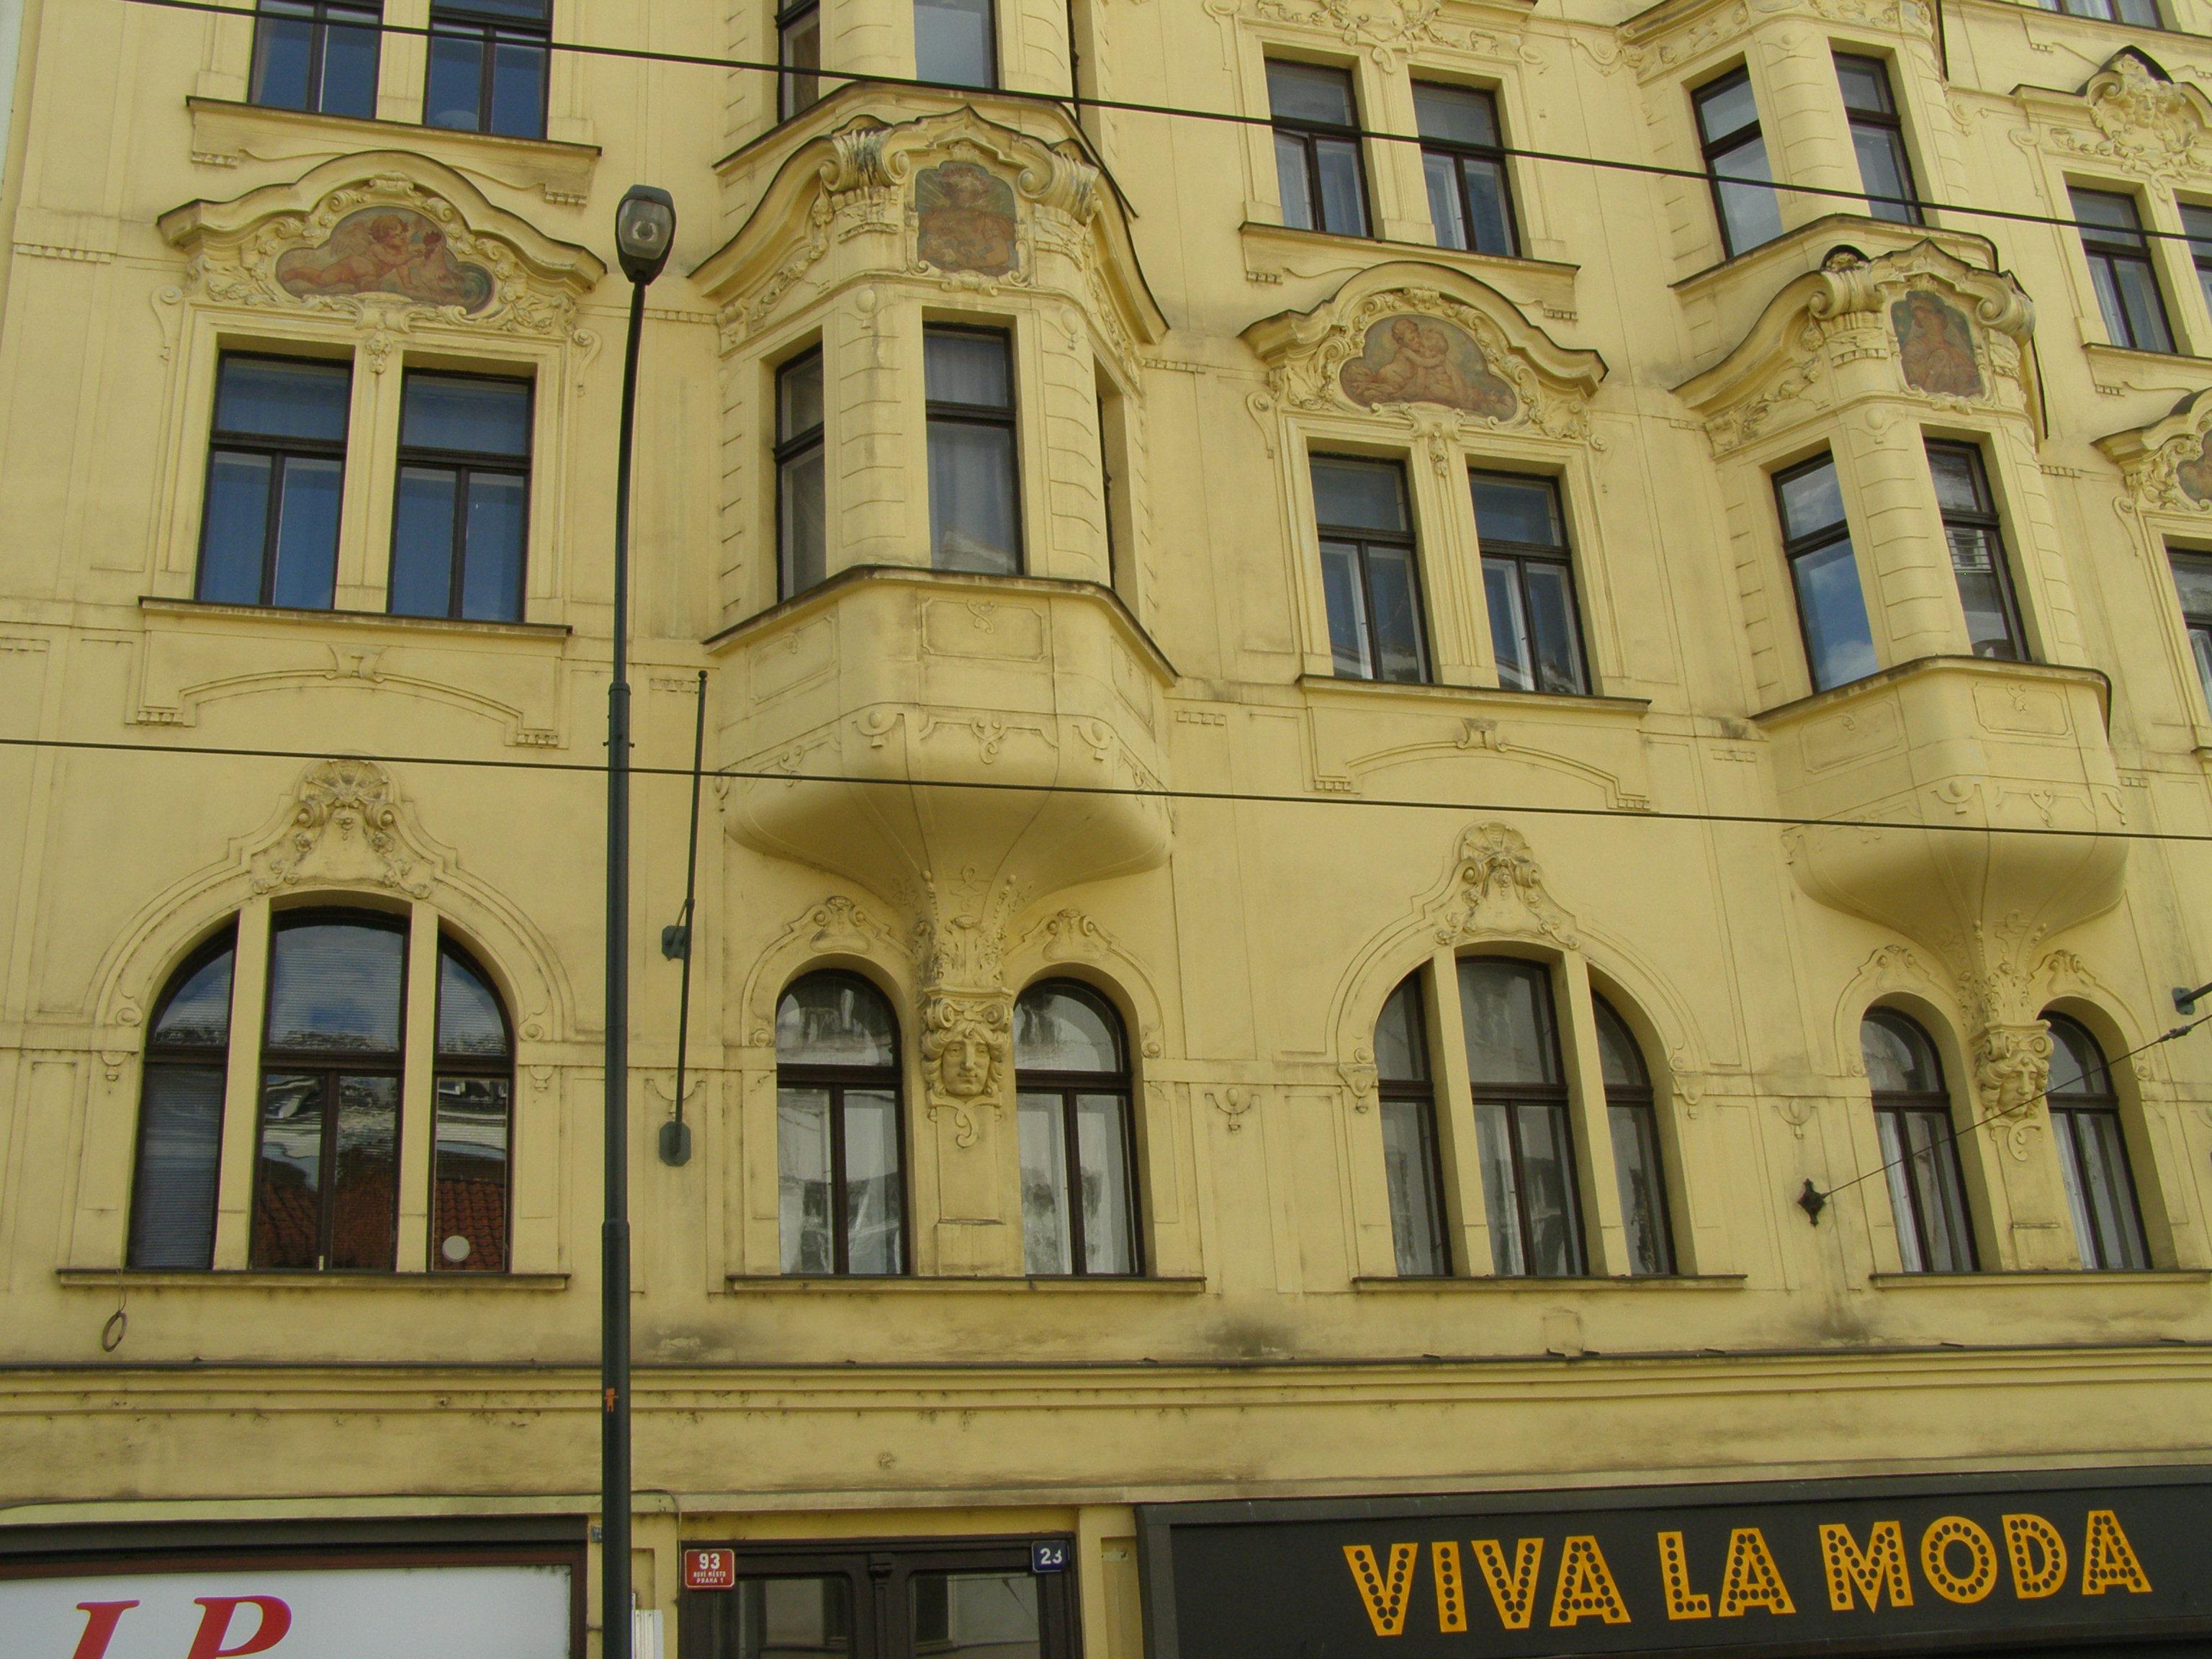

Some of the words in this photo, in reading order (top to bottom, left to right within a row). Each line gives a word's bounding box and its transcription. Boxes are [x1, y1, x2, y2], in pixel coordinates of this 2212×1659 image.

[699, 1553, 720, 1569] 93
[1343, 1535, 1631, 1636] VIVA
[1658, 1528, 1796, 1620] LA
[1820, 1510, 2152, 1612] MODA
